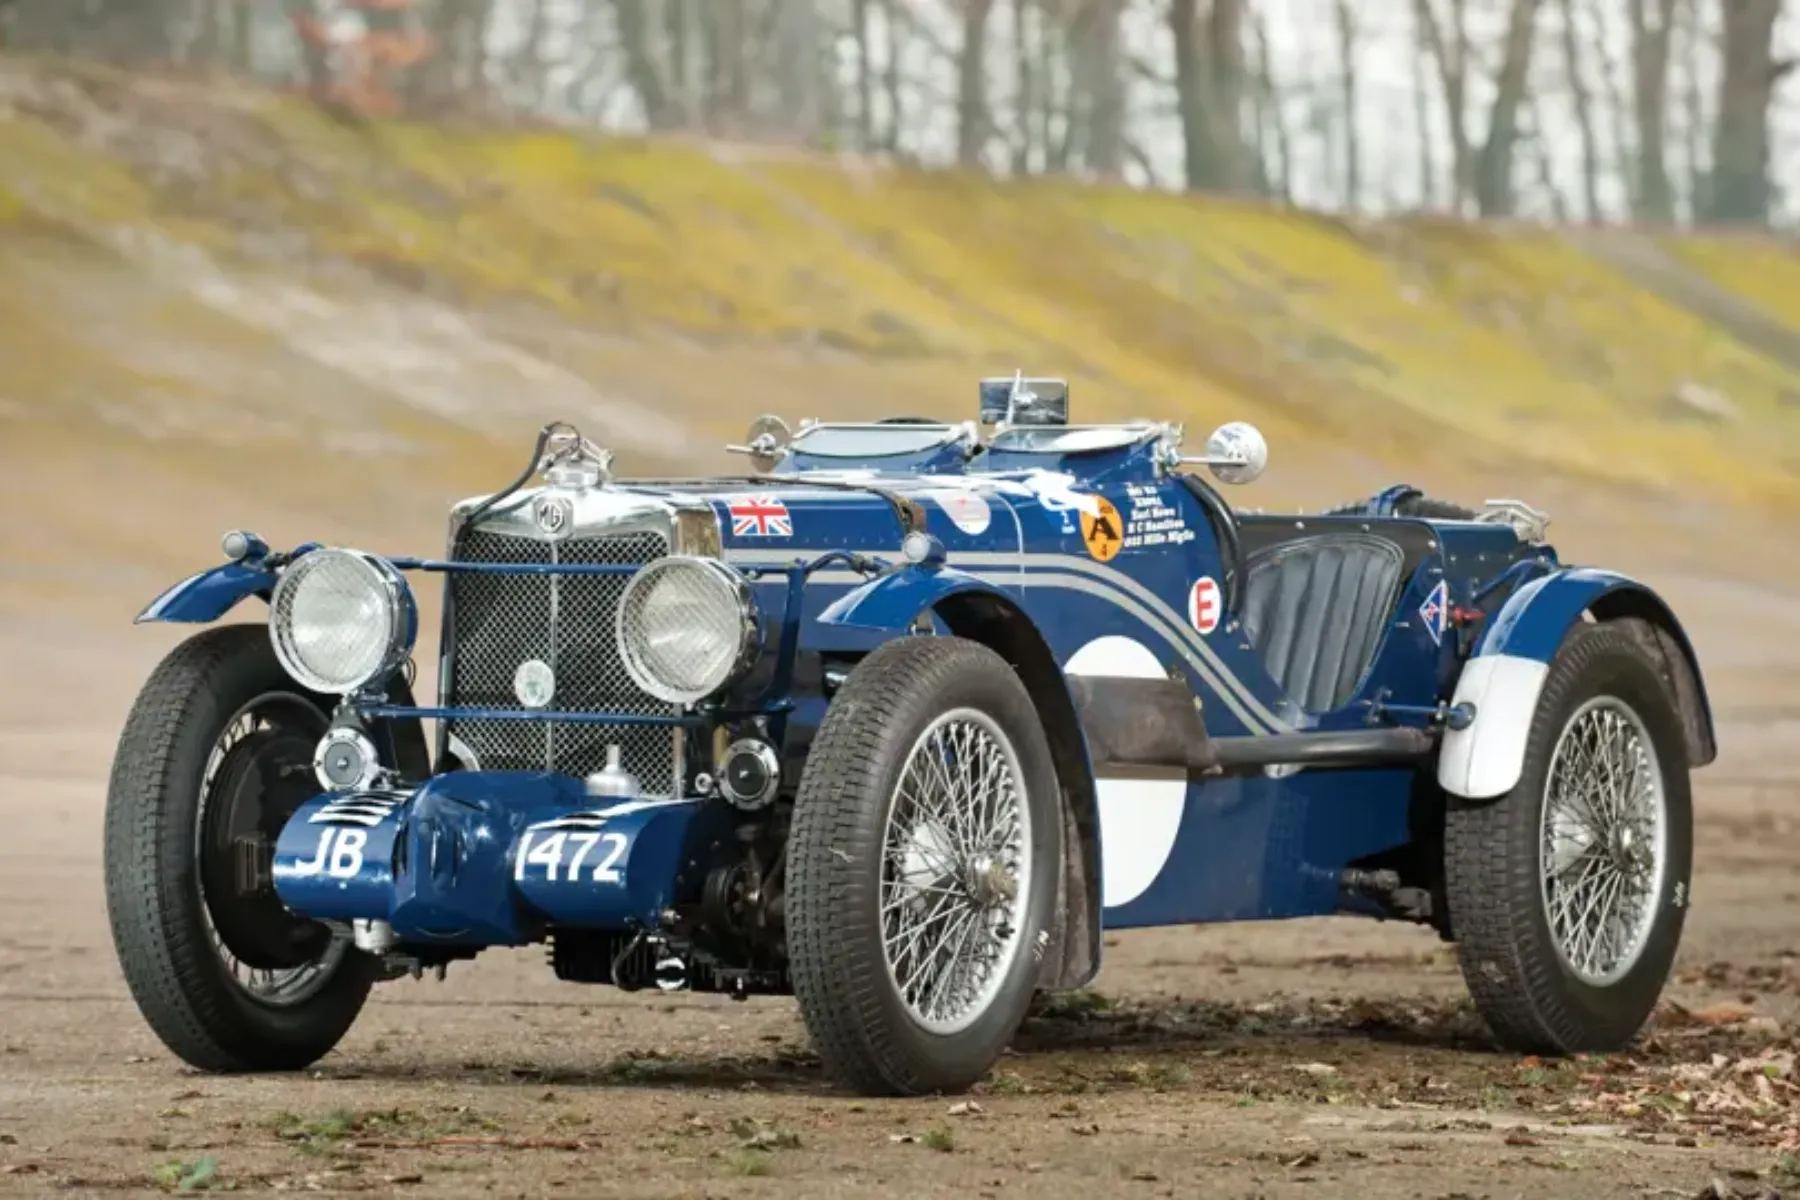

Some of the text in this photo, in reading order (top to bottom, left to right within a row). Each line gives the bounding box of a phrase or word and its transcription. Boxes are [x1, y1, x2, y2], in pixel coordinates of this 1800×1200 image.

[539, 502, 565, 532] MG
[1088, 516, 1120, 541] A
[1196, 582, 1214, 629] E
[295, 826, 628, 882] JB 1472
